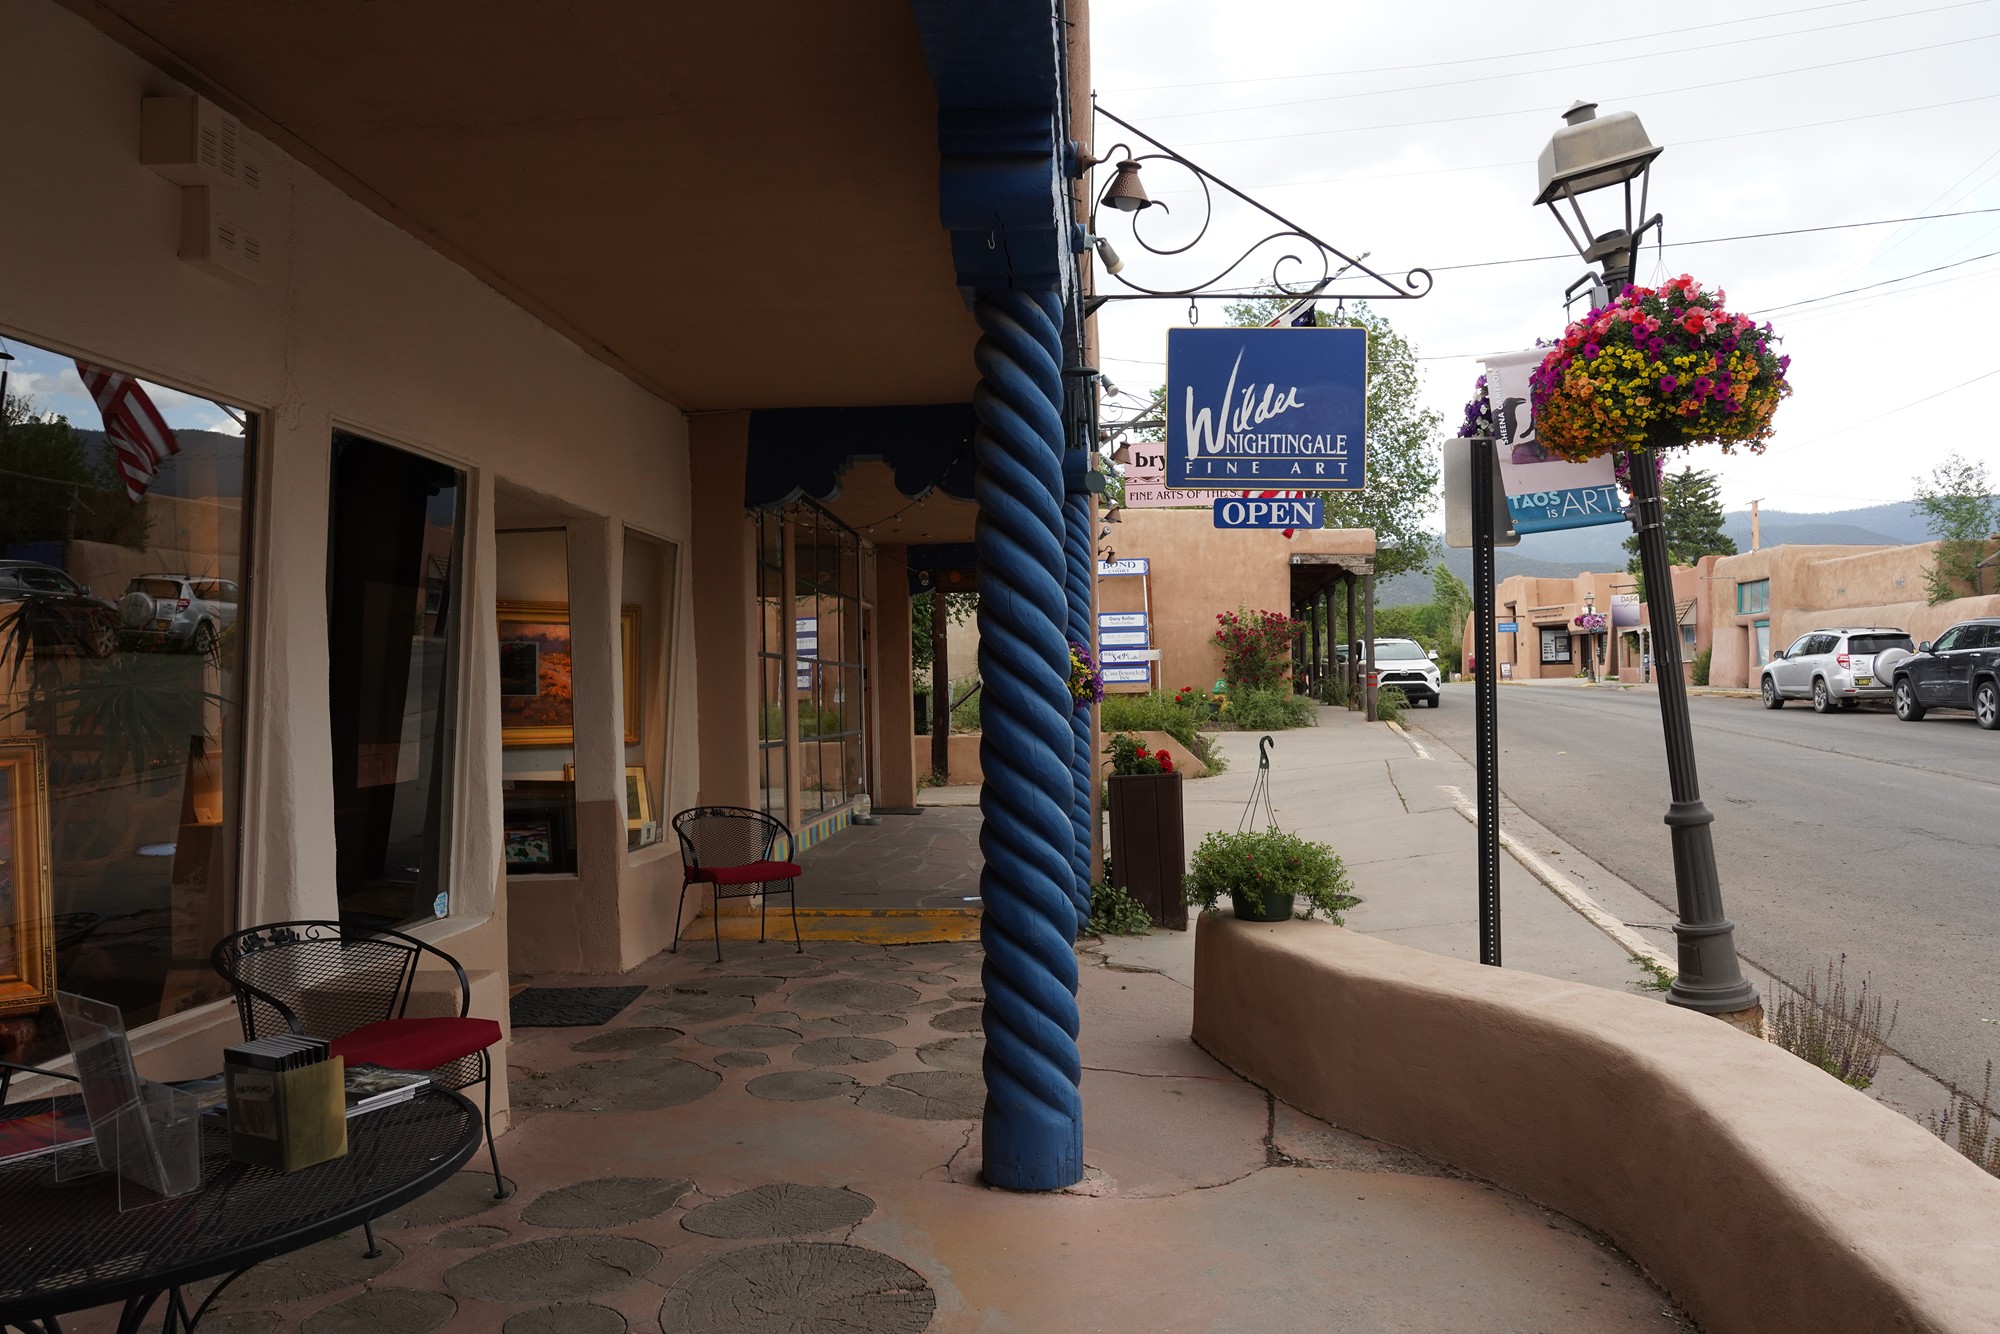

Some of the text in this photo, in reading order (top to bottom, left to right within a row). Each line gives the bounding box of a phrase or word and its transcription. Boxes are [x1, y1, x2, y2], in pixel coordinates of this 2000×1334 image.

[1185, 344, 1305, 460] Wilder
[1493, 368, 1510, 446] SHEENA CAMERON
[1225, 434, 1348, 455] NIGHTINGALE
[1186, 461, 1348, 475] FINE ART
[1129, 491, 1153, 501] FINE
[1156, 490, 1184, 500] ARTS
[1186, 490, 1201, 499] OF
[1508, 486, 1615, 519] TAOS is ART
[1222, 501, 1316, 526] OPEN
